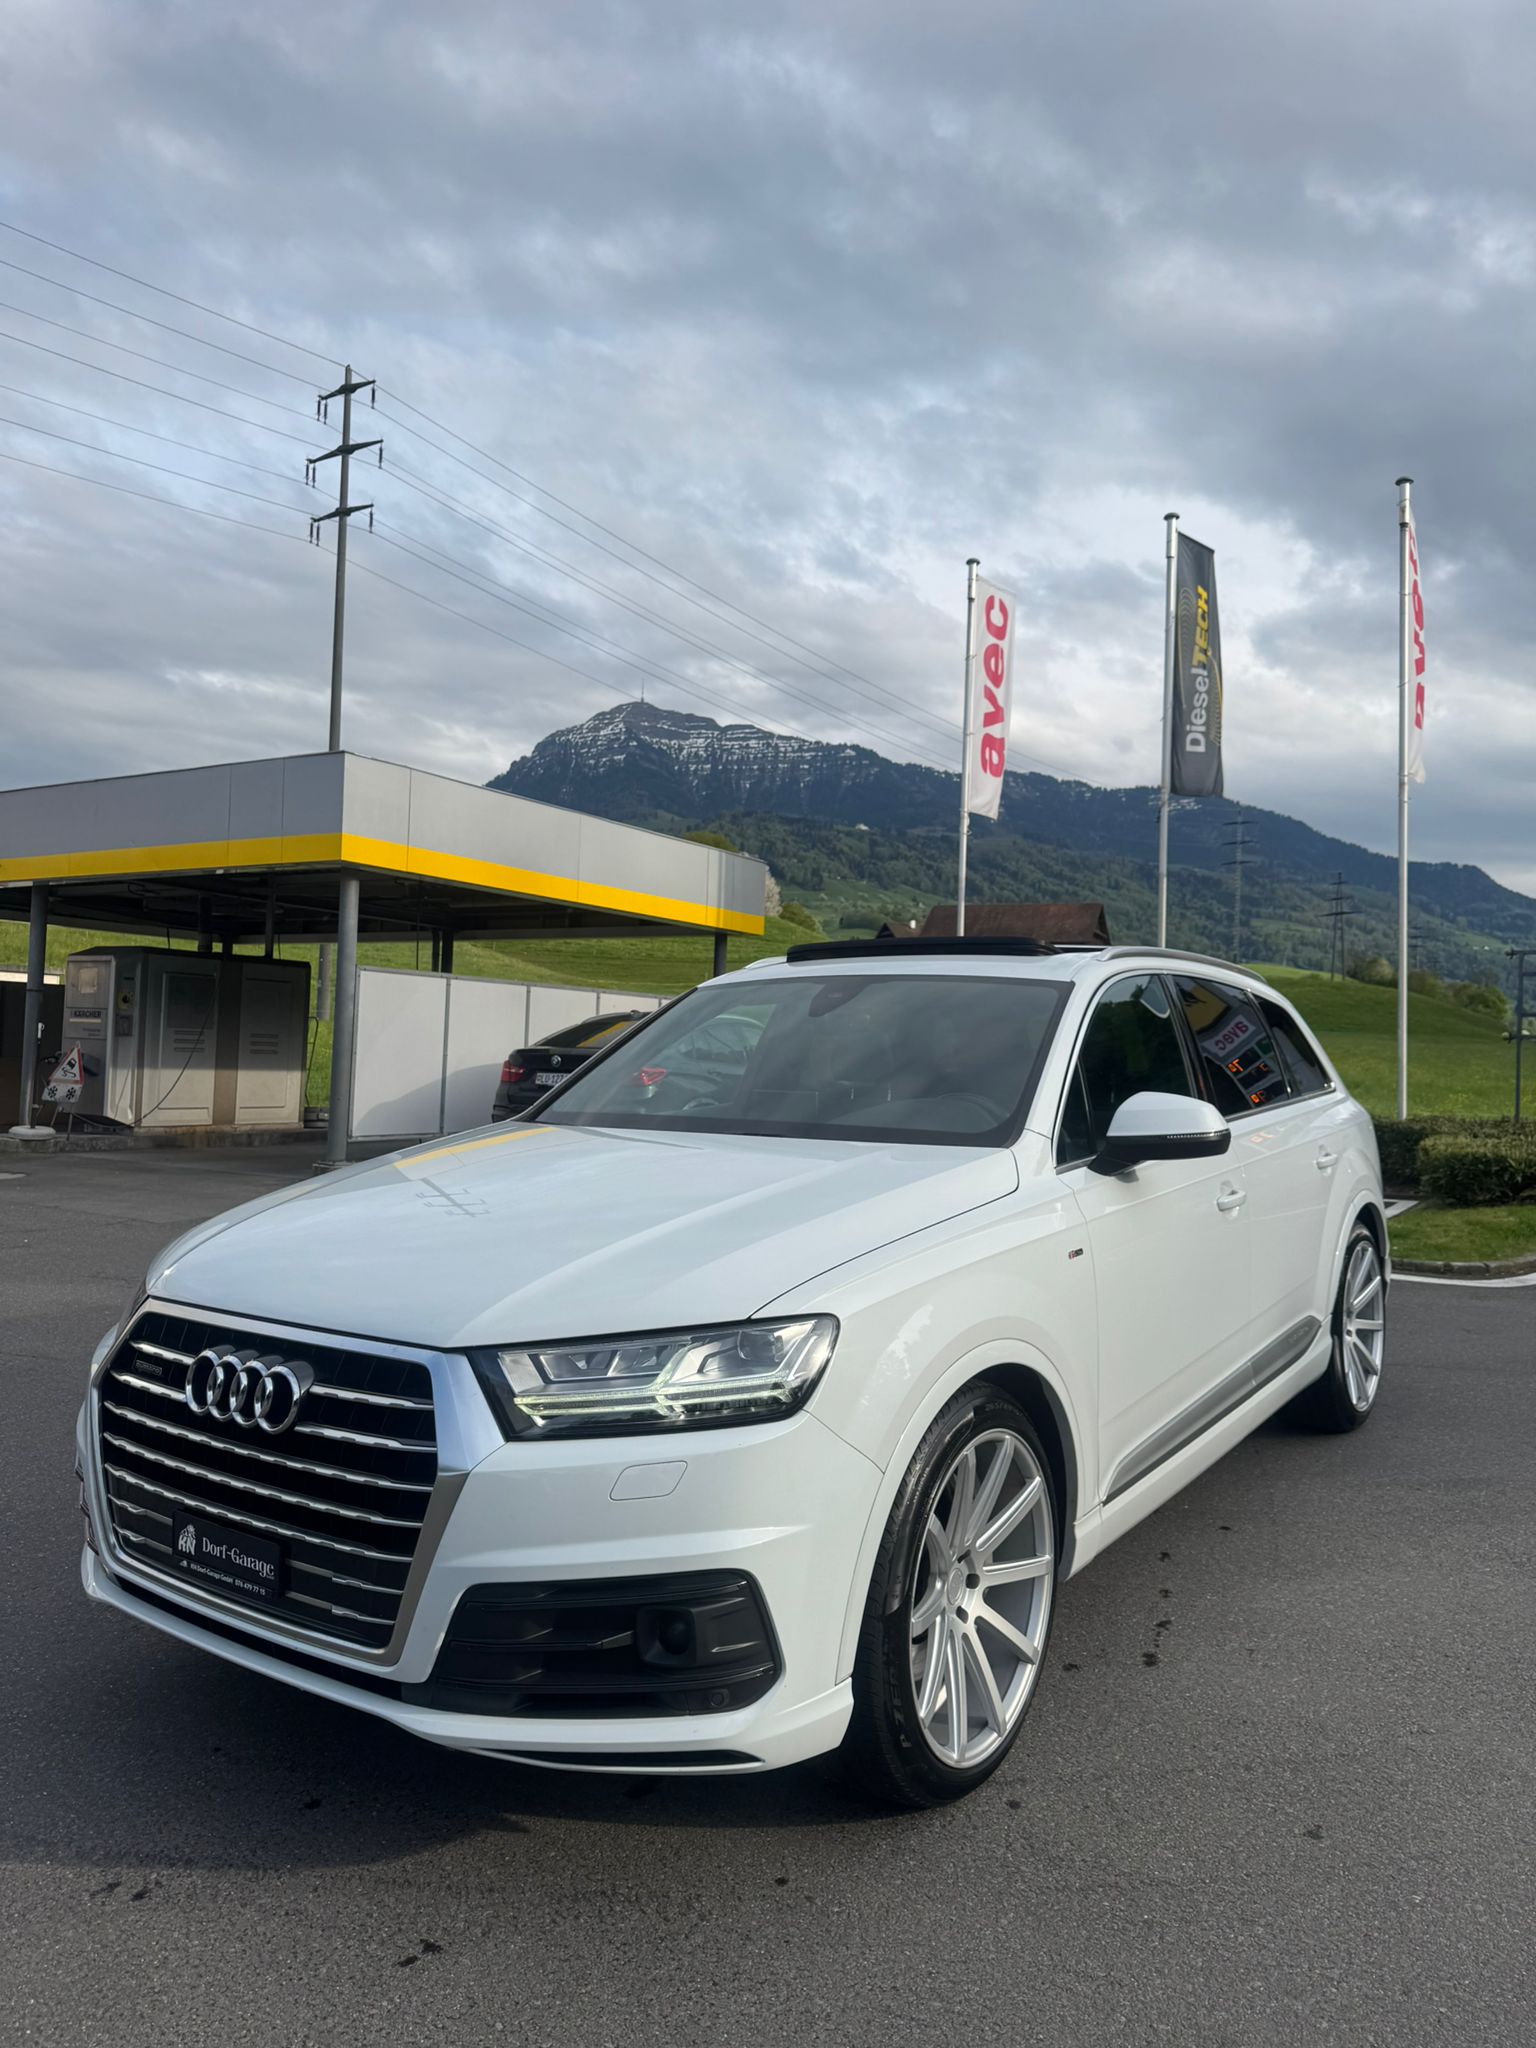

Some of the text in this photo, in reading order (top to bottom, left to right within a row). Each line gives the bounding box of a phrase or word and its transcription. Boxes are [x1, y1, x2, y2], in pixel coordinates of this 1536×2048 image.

[980, 594, 1009, 778] avec
[1186, 585, 1210, 753] DieselTECH
[178, 1535, 196, 1555] KN
[202, 1537, 275, 1578] Dorf-Garage
